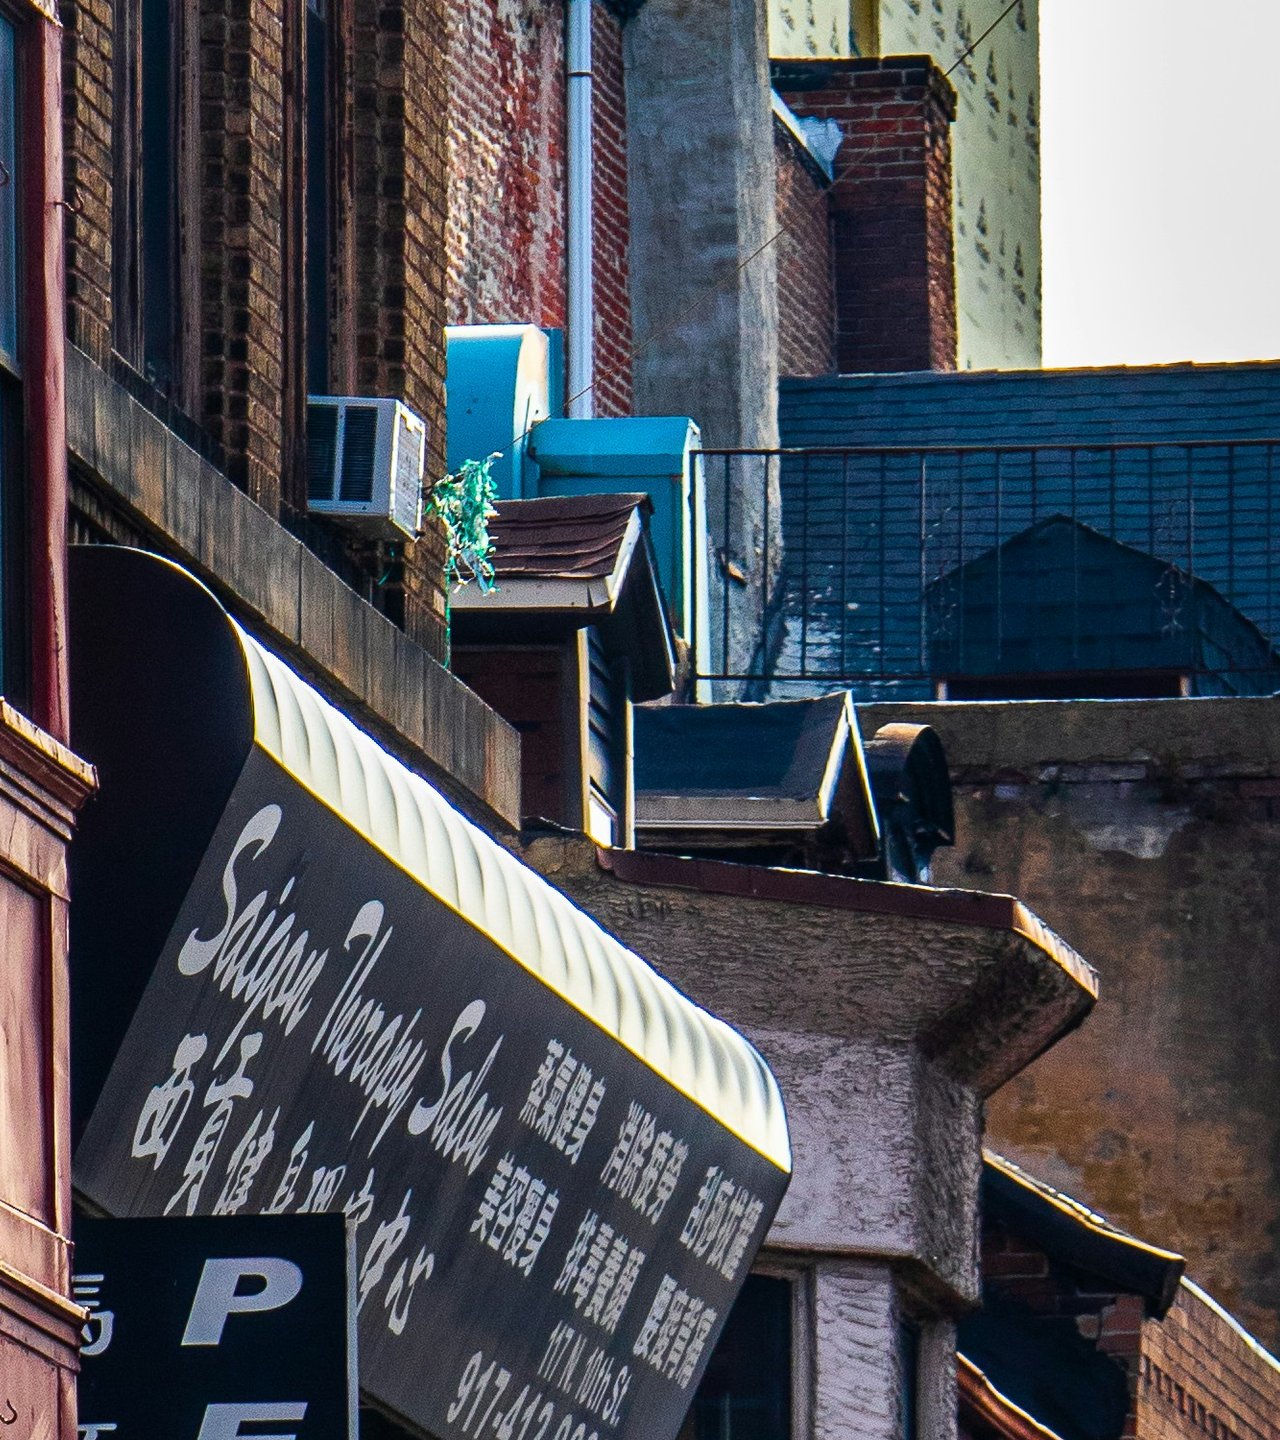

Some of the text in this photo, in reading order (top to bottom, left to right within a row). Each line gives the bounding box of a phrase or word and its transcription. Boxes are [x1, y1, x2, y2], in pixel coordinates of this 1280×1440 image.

[178, 803, 504, 1175] Saigon Therapy Salon
[537, 1320, 575, 1382] 117
[575, 1346, 614, 1414] 10th
[602, 1365, 633, 1427] St.
